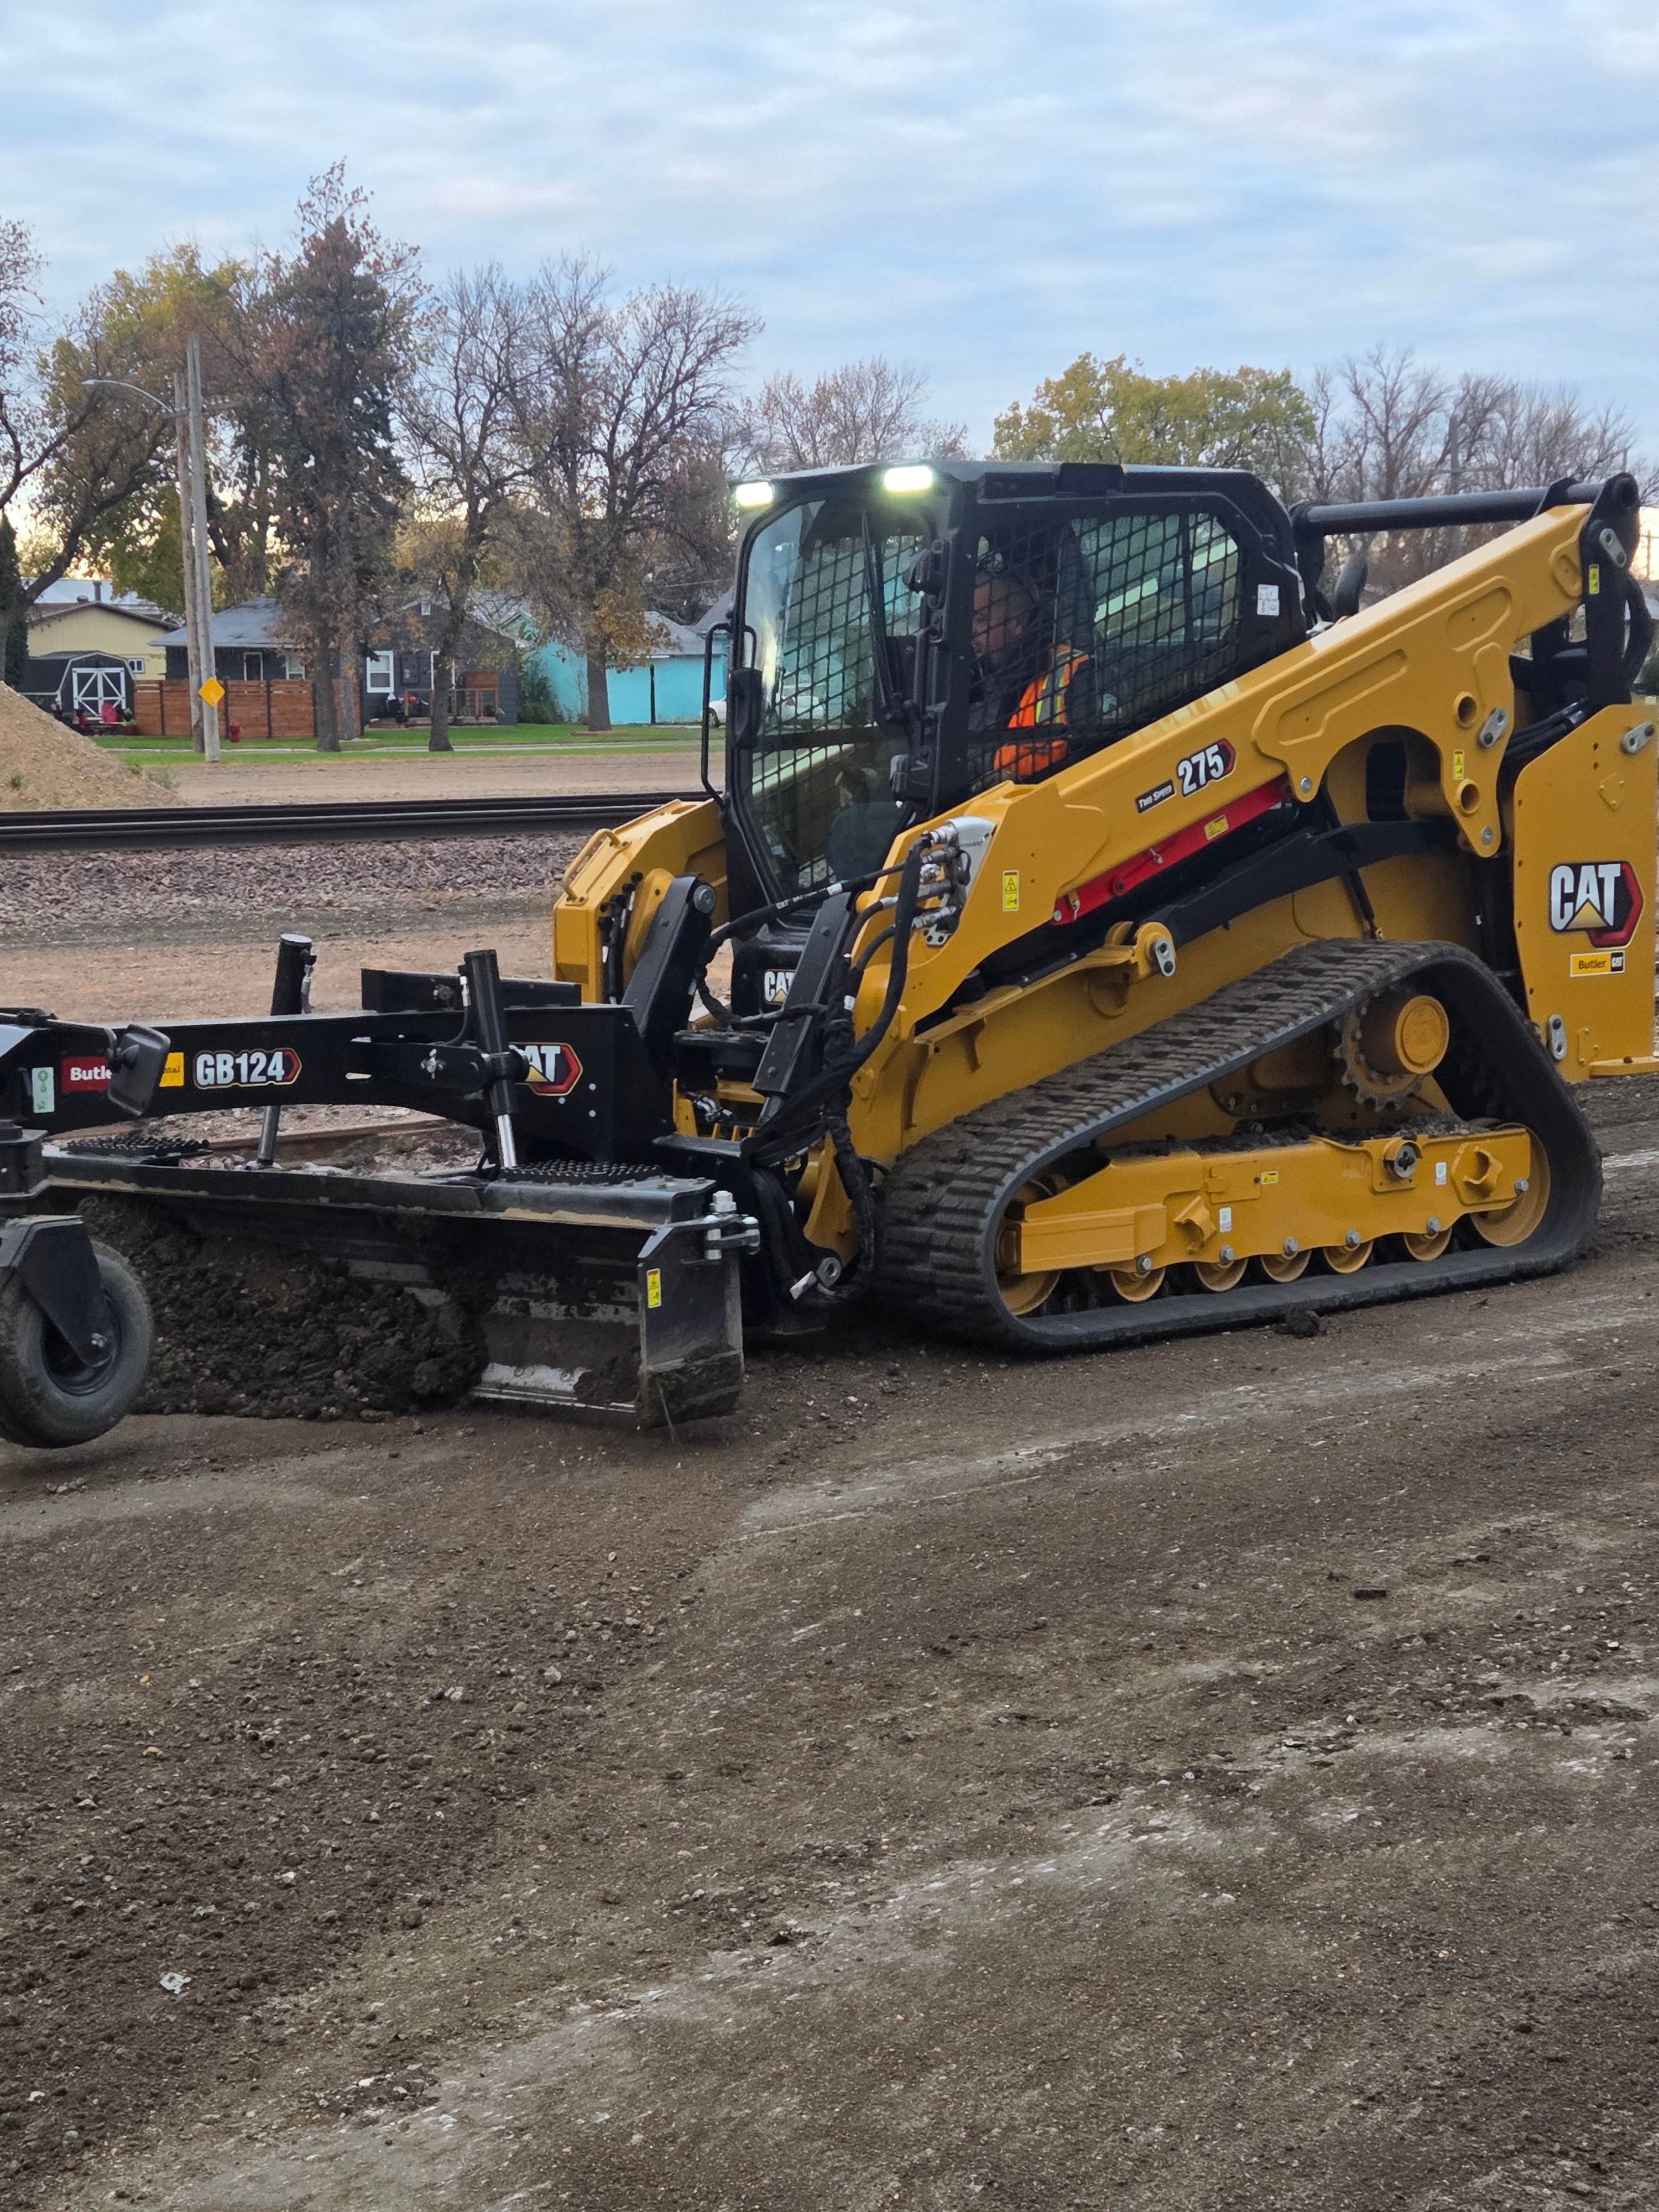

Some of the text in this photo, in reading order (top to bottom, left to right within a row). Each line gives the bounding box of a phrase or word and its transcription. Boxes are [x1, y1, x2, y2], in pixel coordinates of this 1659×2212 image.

[1178, 744, 1224, 795] 275
[1551, 863, 1621, 930] CAT
[1578, 959, 1606, 969] Butler
[70, 1065, 112, 1081] Butle
[196, 1051, 285, 1086] GB124
[508, 1044, 561, 1082] AT
